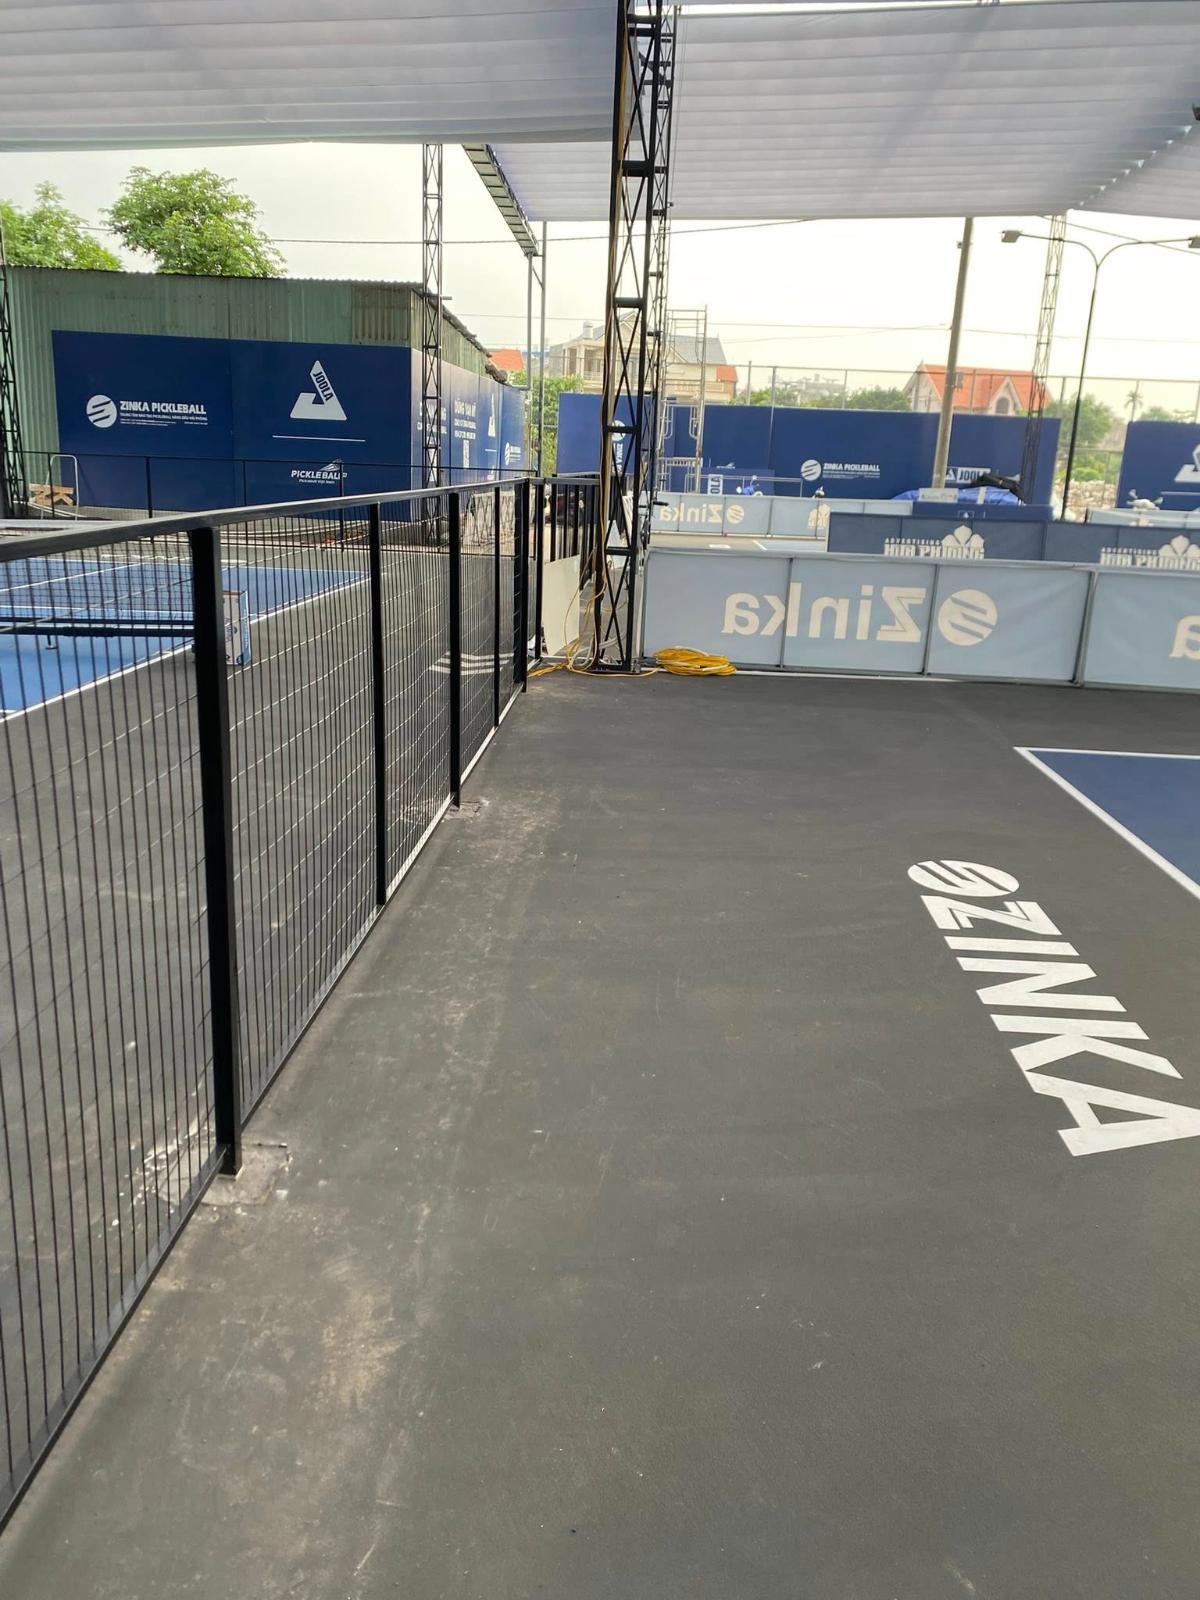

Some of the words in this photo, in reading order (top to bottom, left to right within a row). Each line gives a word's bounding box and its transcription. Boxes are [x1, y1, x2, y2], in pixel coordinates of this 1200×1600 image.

[312, 371, 334, 402] JOOLA
[119, 400, 150, 412] ZINKA
[151, 402, 207, 415] PICKLEBALL
[920, 895, 1200, 1157] ZINKA
